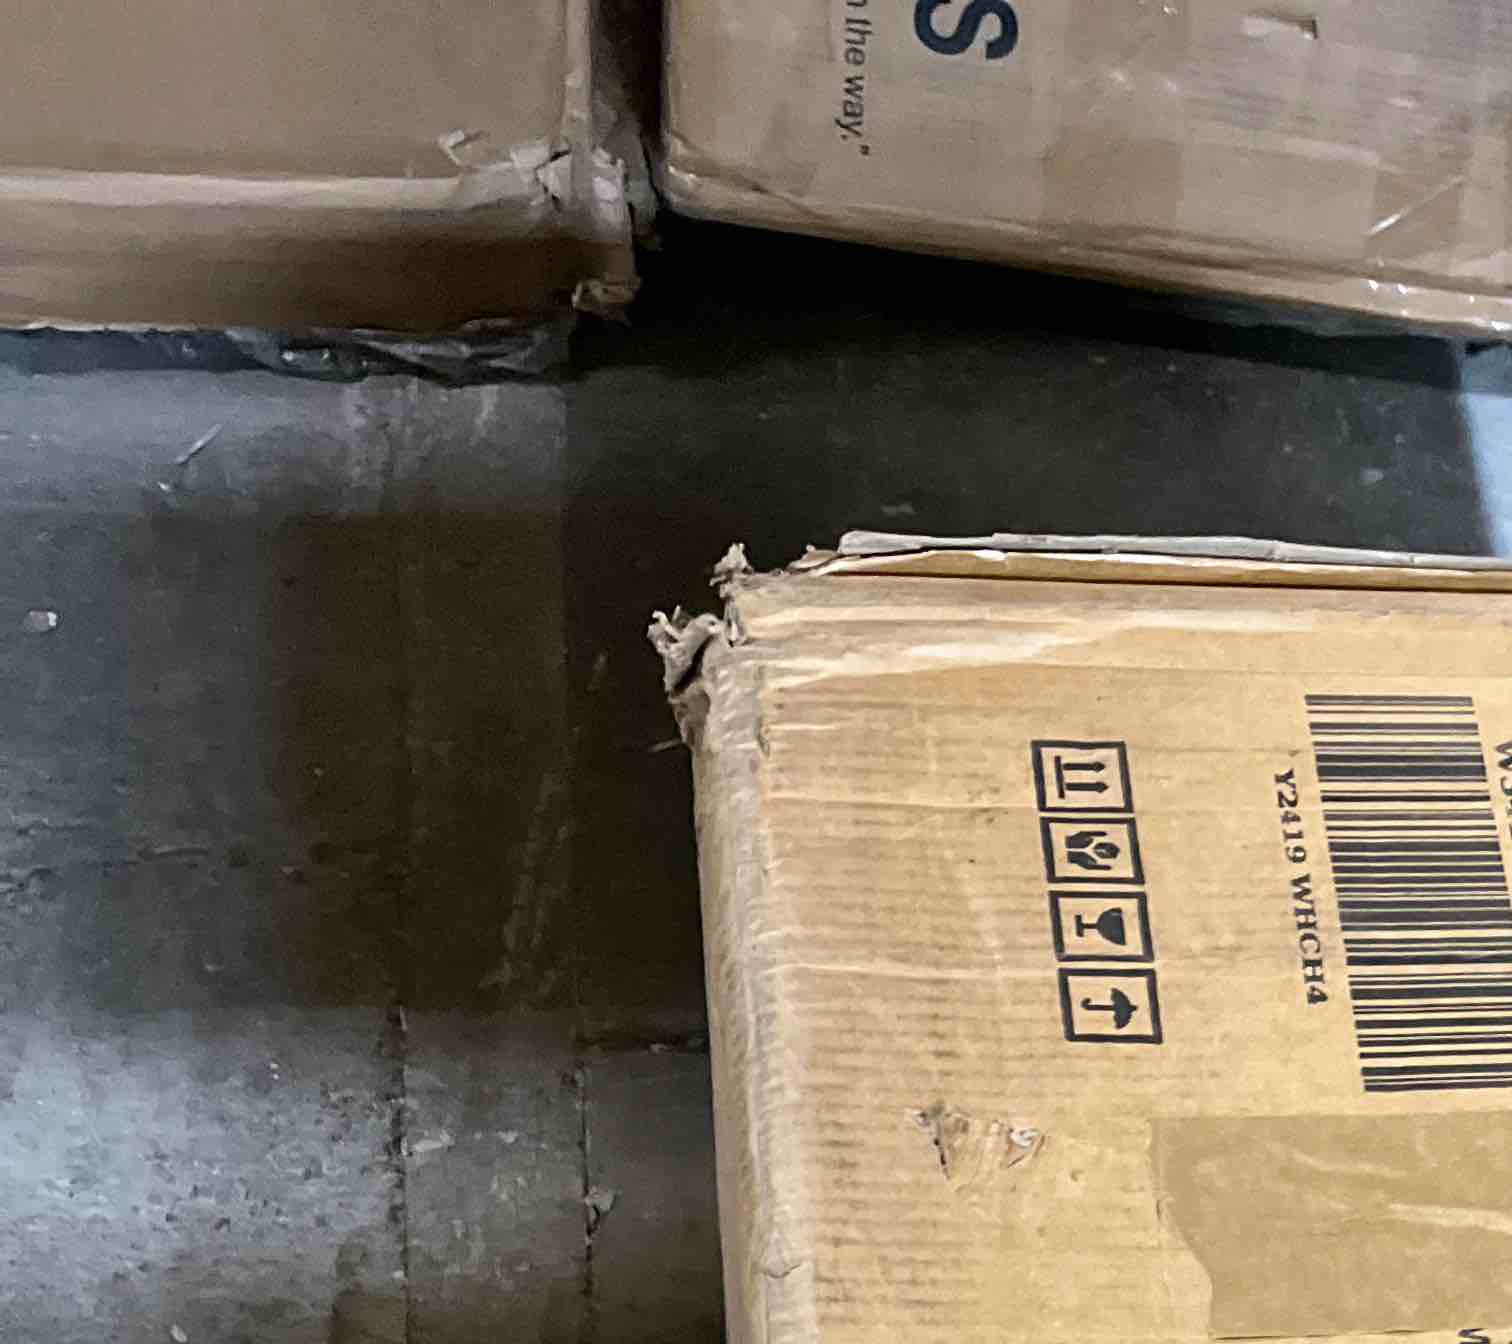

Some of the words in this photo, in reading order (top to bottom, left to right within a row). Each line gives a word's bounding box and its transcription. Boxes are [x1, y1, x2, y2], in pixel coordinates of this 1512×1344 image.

[914, 0, 1018, 60] S
[1273, 767, 1307, 866] Y2419
[1289, 872, 1329, 1005] WHCH4
